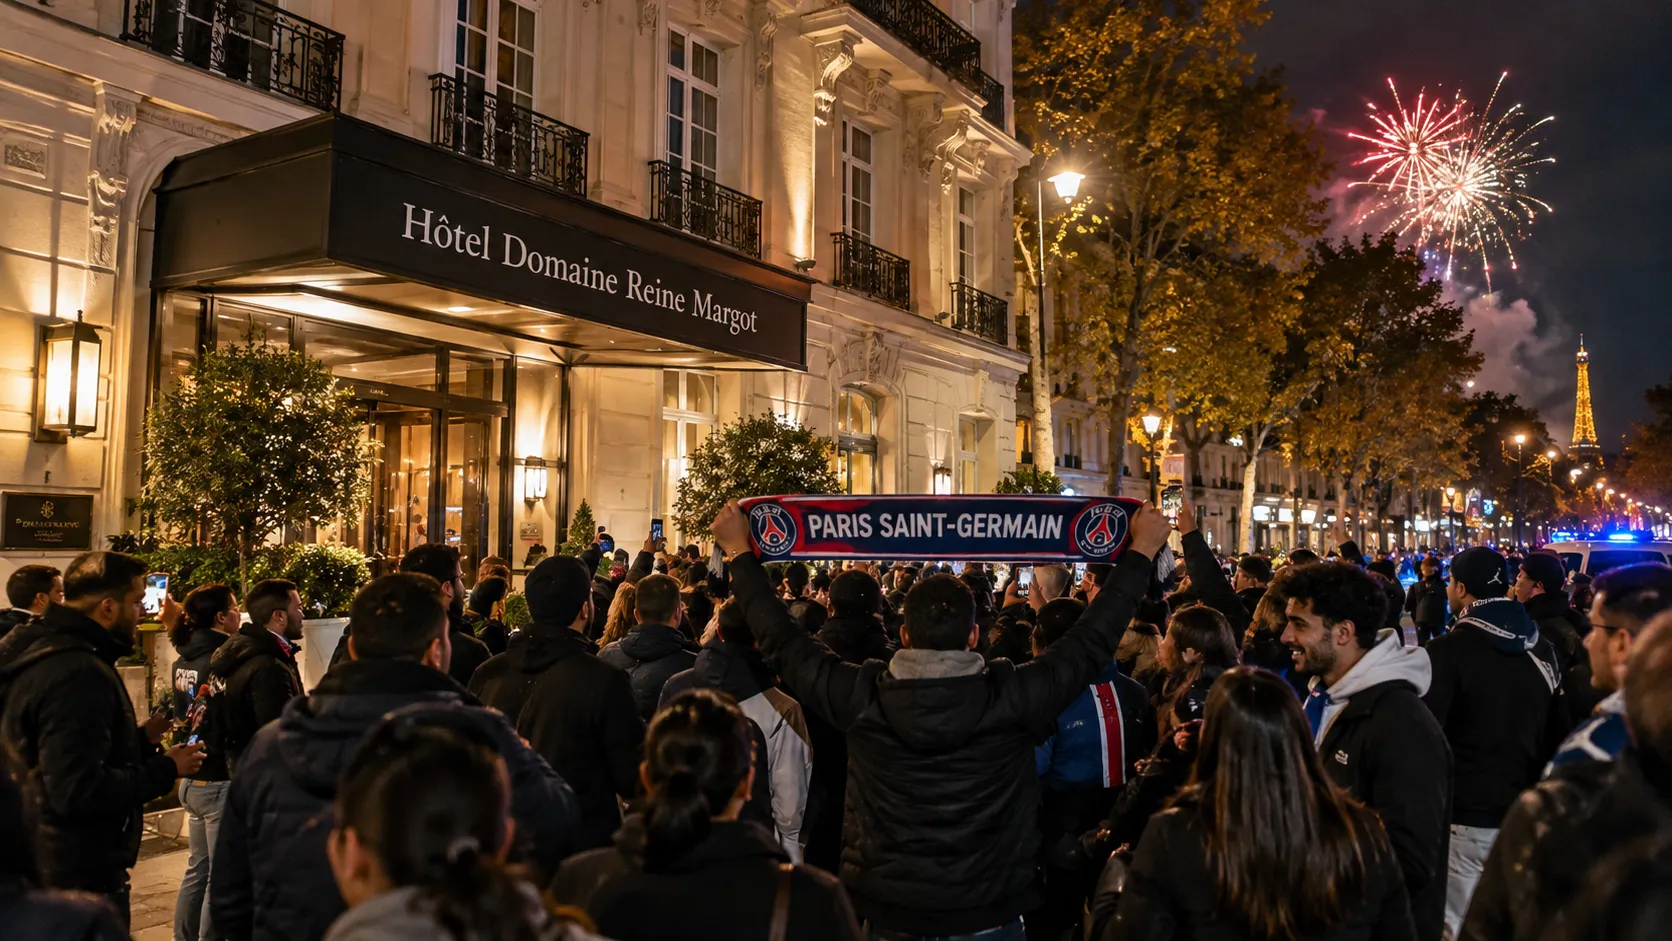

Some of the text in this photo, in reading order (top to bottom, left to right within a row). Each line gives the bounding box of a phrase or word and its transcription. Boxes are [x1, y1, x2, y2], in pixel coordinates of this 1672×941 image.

[402, 202, 758, 336] Hôtel Domaine Reine Margot
[808, 513, 1063, 540] PARIS SAINT-GERMAIN
